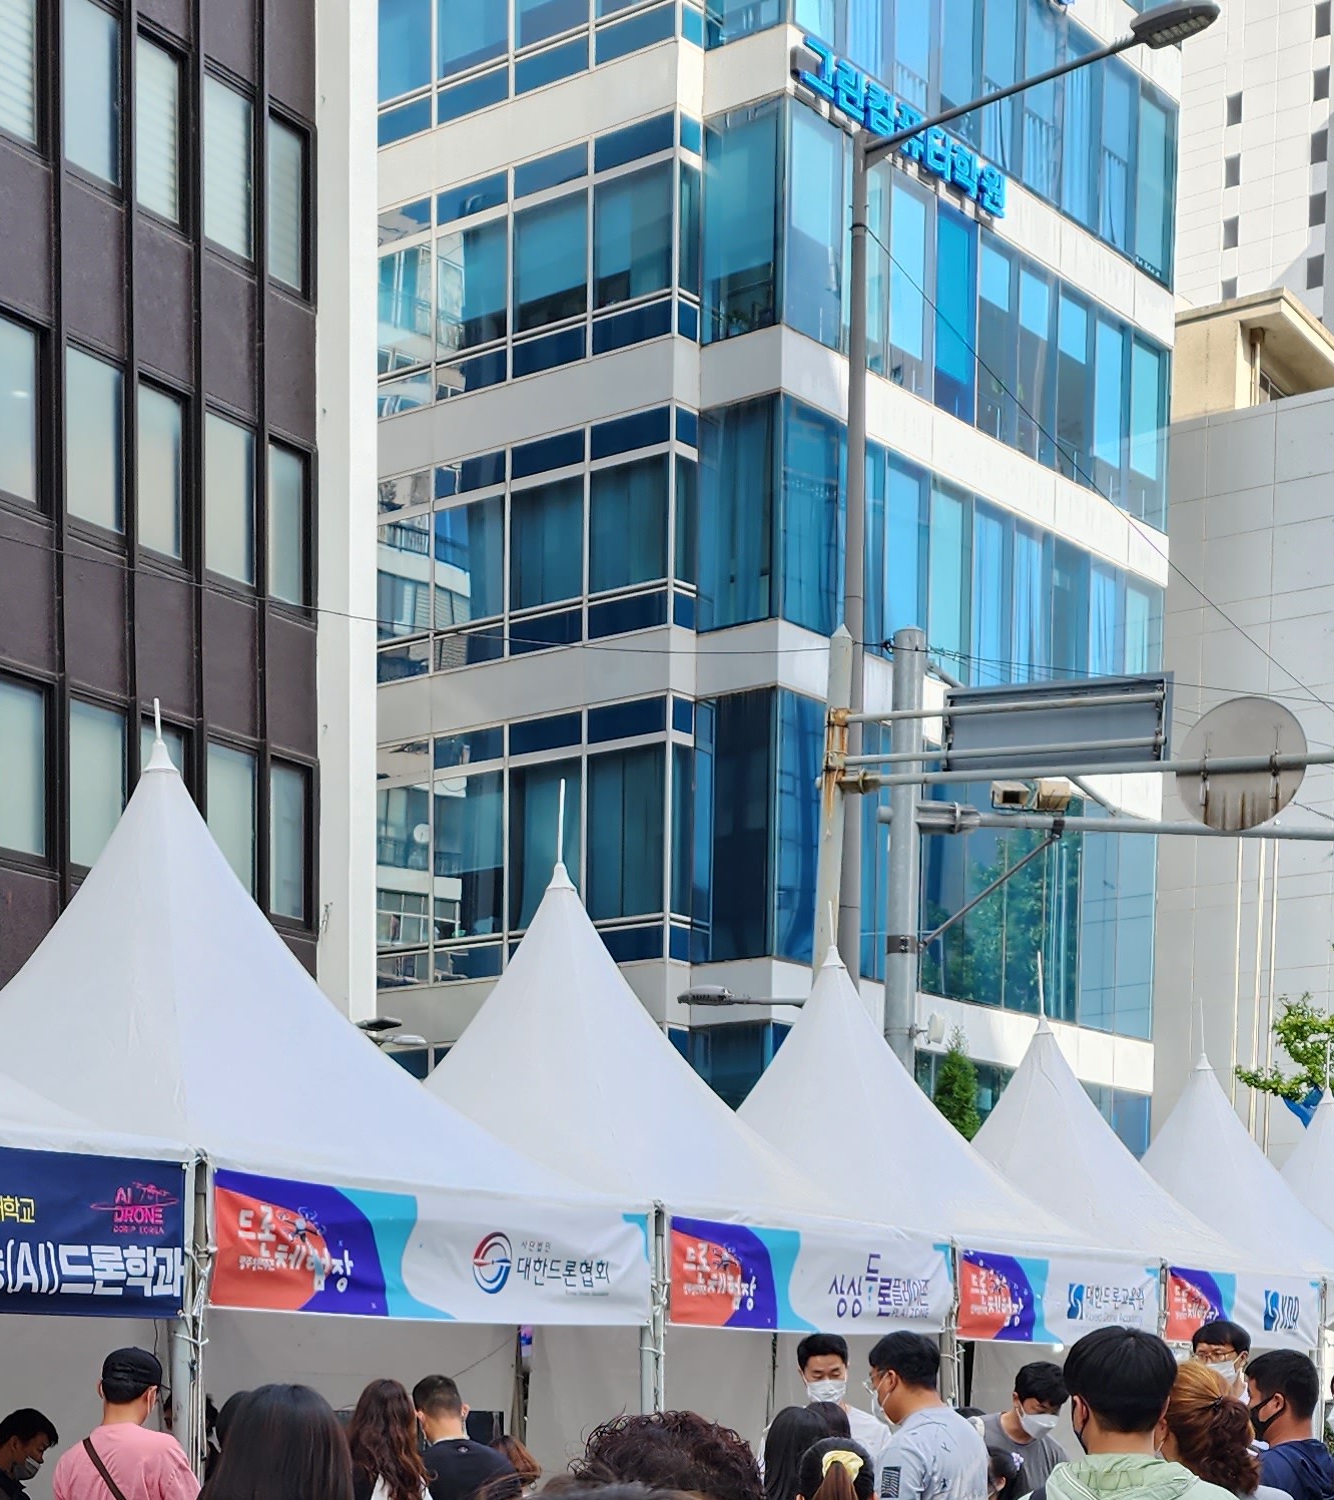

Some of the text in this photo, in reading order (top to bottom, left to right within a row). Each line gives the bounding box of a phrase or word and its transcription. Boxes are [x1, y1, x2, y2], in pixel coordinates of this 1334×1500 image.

[115, 1187, 132, 1204] AI
[113, 1205, 164, 1224] DRONE
[516, 1257, 610, 1288] 대한드론협회
[1086, 1285, 1145, 1311] 대한드론교육원
